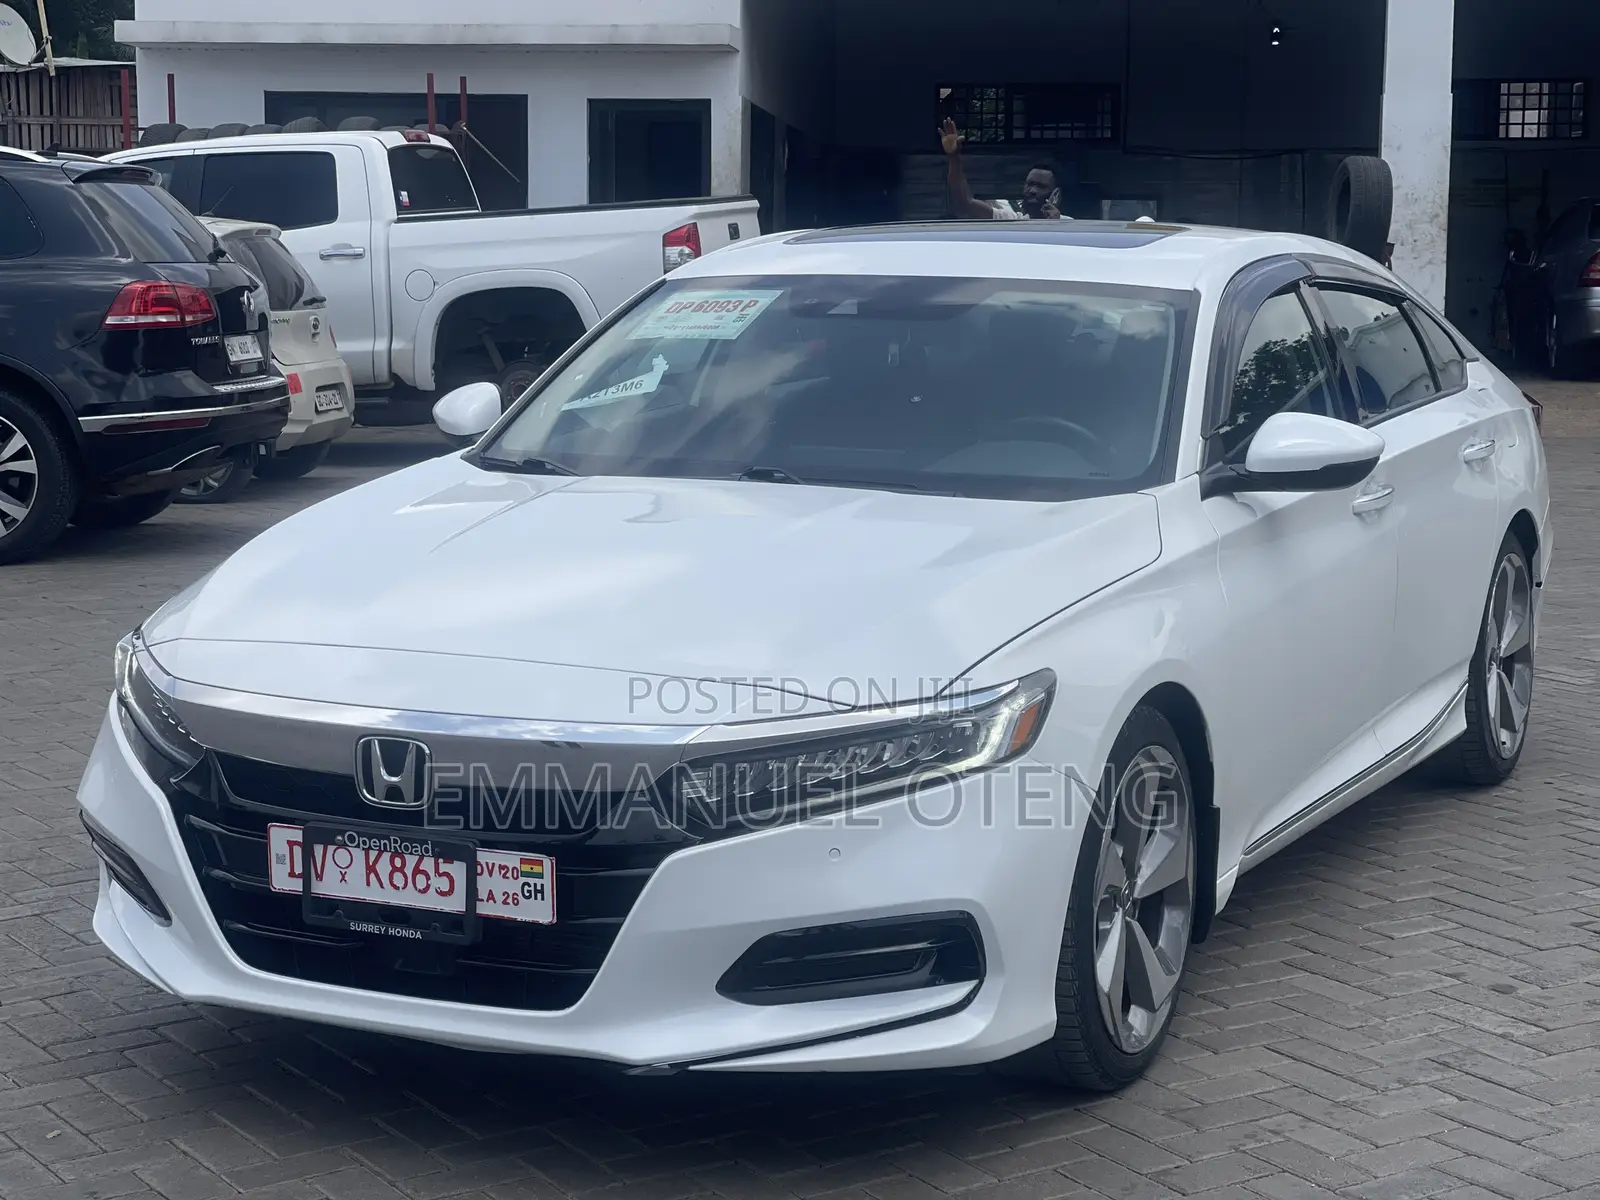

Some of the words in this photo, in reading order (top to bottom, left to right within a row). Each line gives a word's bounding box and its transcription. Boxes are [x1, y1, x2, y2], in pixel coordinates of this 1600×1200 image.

[690, 300, 744, 314] 6093
[740, 300, 760, 313] P
[344, 831, 433, 857] OpenRoad
[363, 847, 456, 897] K865
[501, 890, 520, 906] 26
[520, 881, 545, 901] GH
[349, 921, 386, 935] SURREY
[388, 926, 422, 940] HONDA
